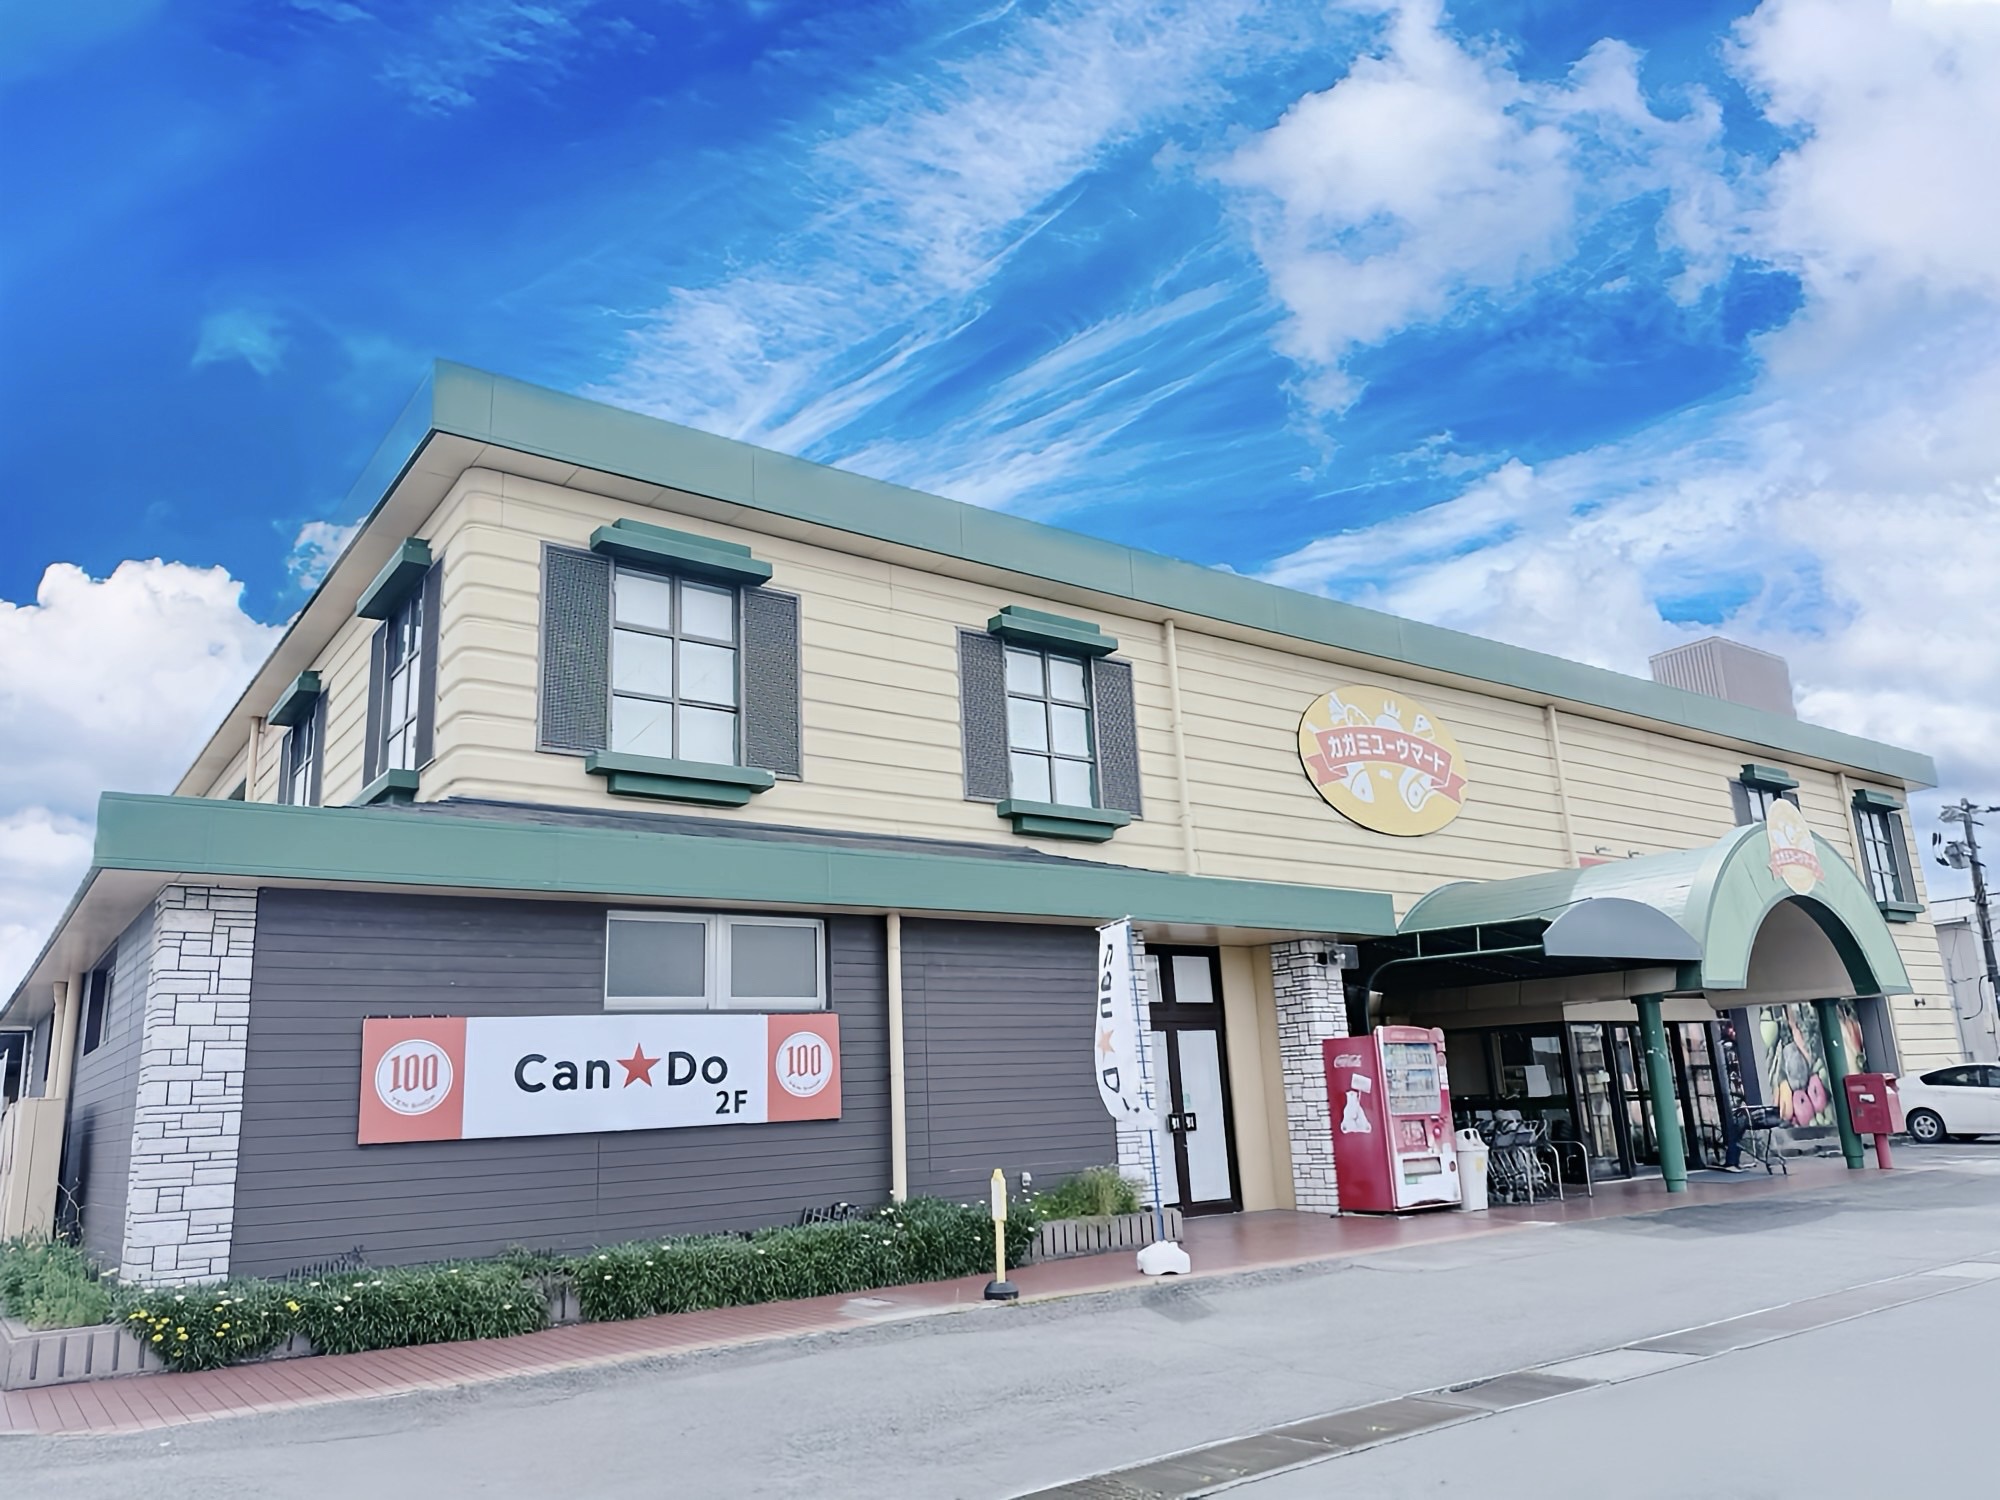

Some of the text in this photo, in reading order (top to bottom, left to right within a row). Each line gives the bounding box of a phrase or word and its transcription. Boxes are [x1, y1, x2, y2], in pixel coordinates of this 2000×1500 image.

[389, 1053, 439, 1093] 100
[514, 1050, 729, 1093] Can Do
[787, 1044, 821, 1077] 100
[715, 1089, 748, 1115] 2F
